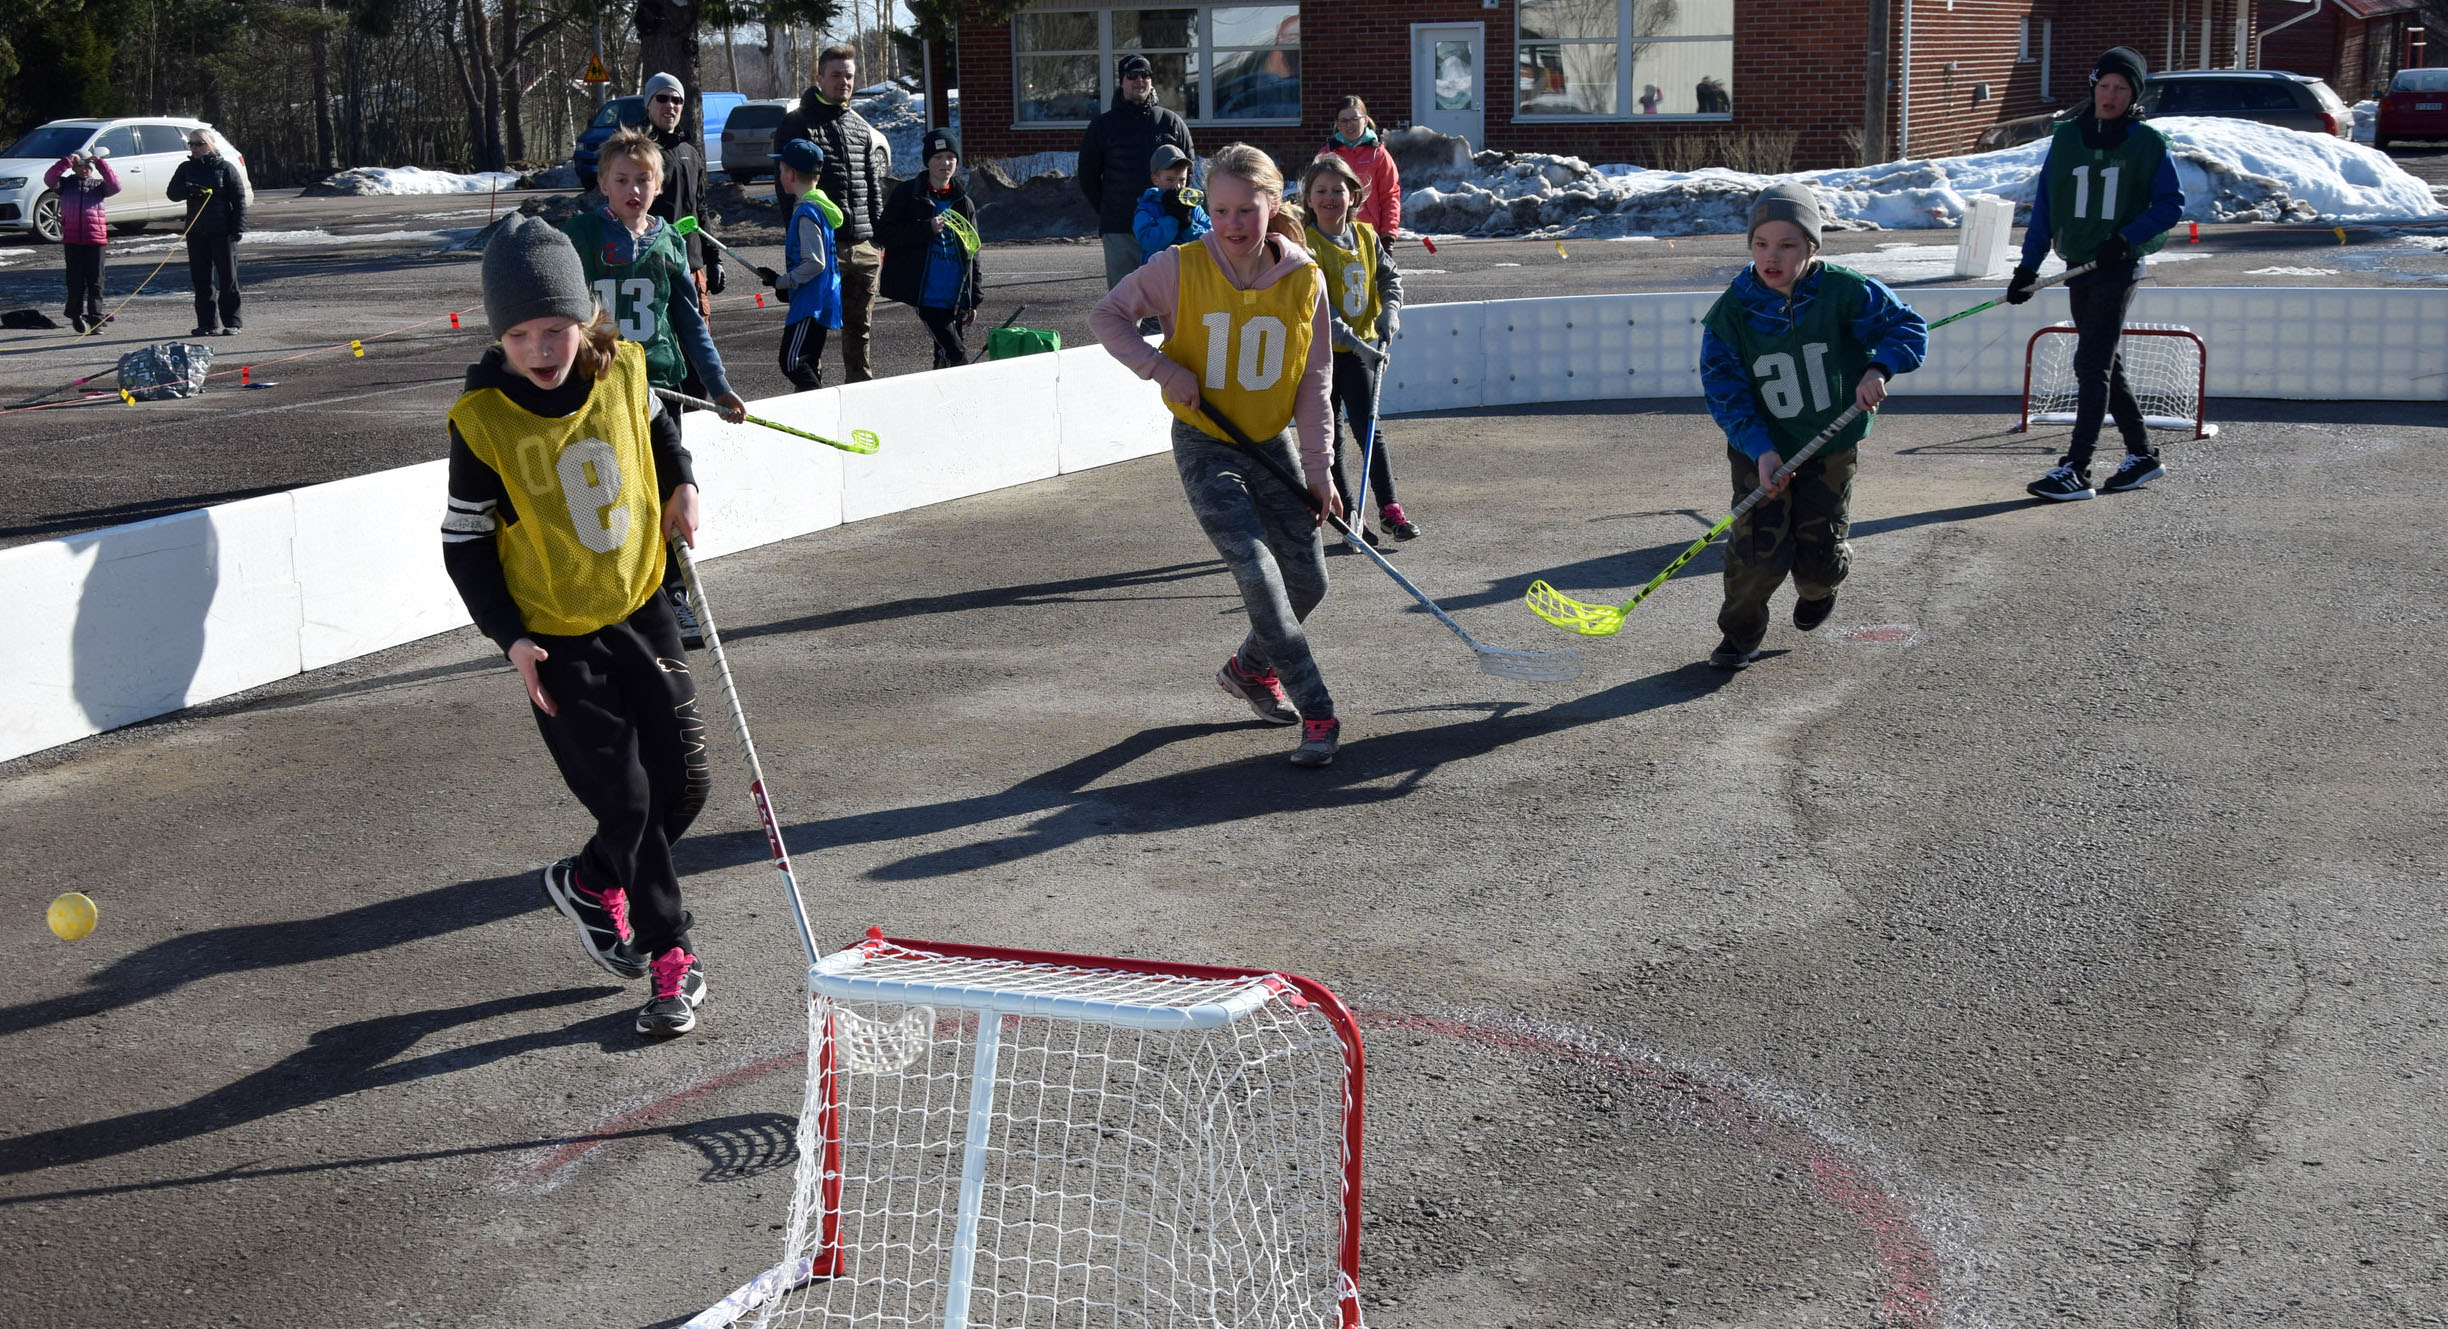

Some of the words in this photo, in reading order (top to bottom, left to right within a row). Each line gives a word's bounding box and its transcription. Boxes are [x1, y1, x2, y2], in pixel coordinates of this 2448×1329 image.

[2072, 165, 2120, 220] 11
[594, 278, 655, 342] 13
[1343, 262, 1368, 317] 8
[1202, 311, 1287, 391] 10
[755, 792, 776, 850] EXEL
